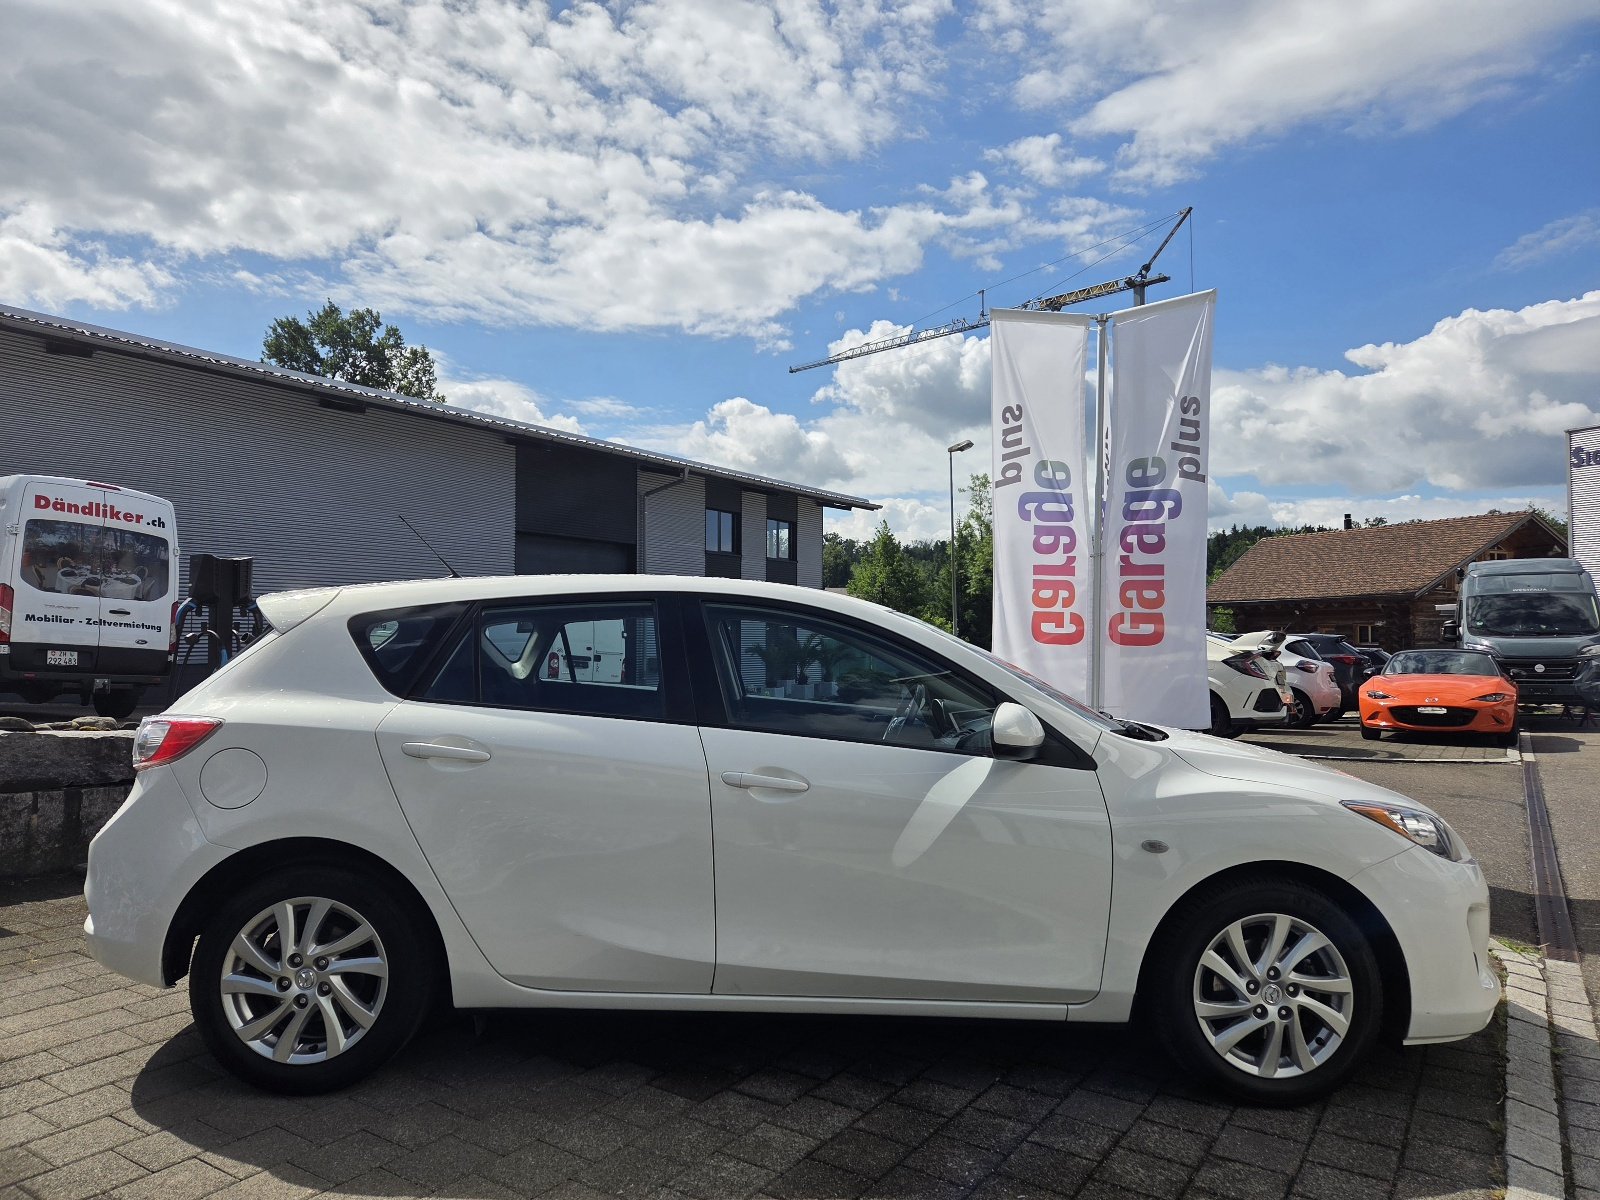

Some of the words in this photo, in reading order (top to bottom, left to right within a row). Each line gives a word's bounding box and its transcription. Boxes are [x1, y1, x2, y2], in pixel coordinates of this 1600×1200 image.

[1171, 395, 1206, 484] plus
[1108, 456, 1182, 647] Garage
[25, 613, 75, 624] Mobiliar
[85, 618, 162, 632] Zeltvermietung
